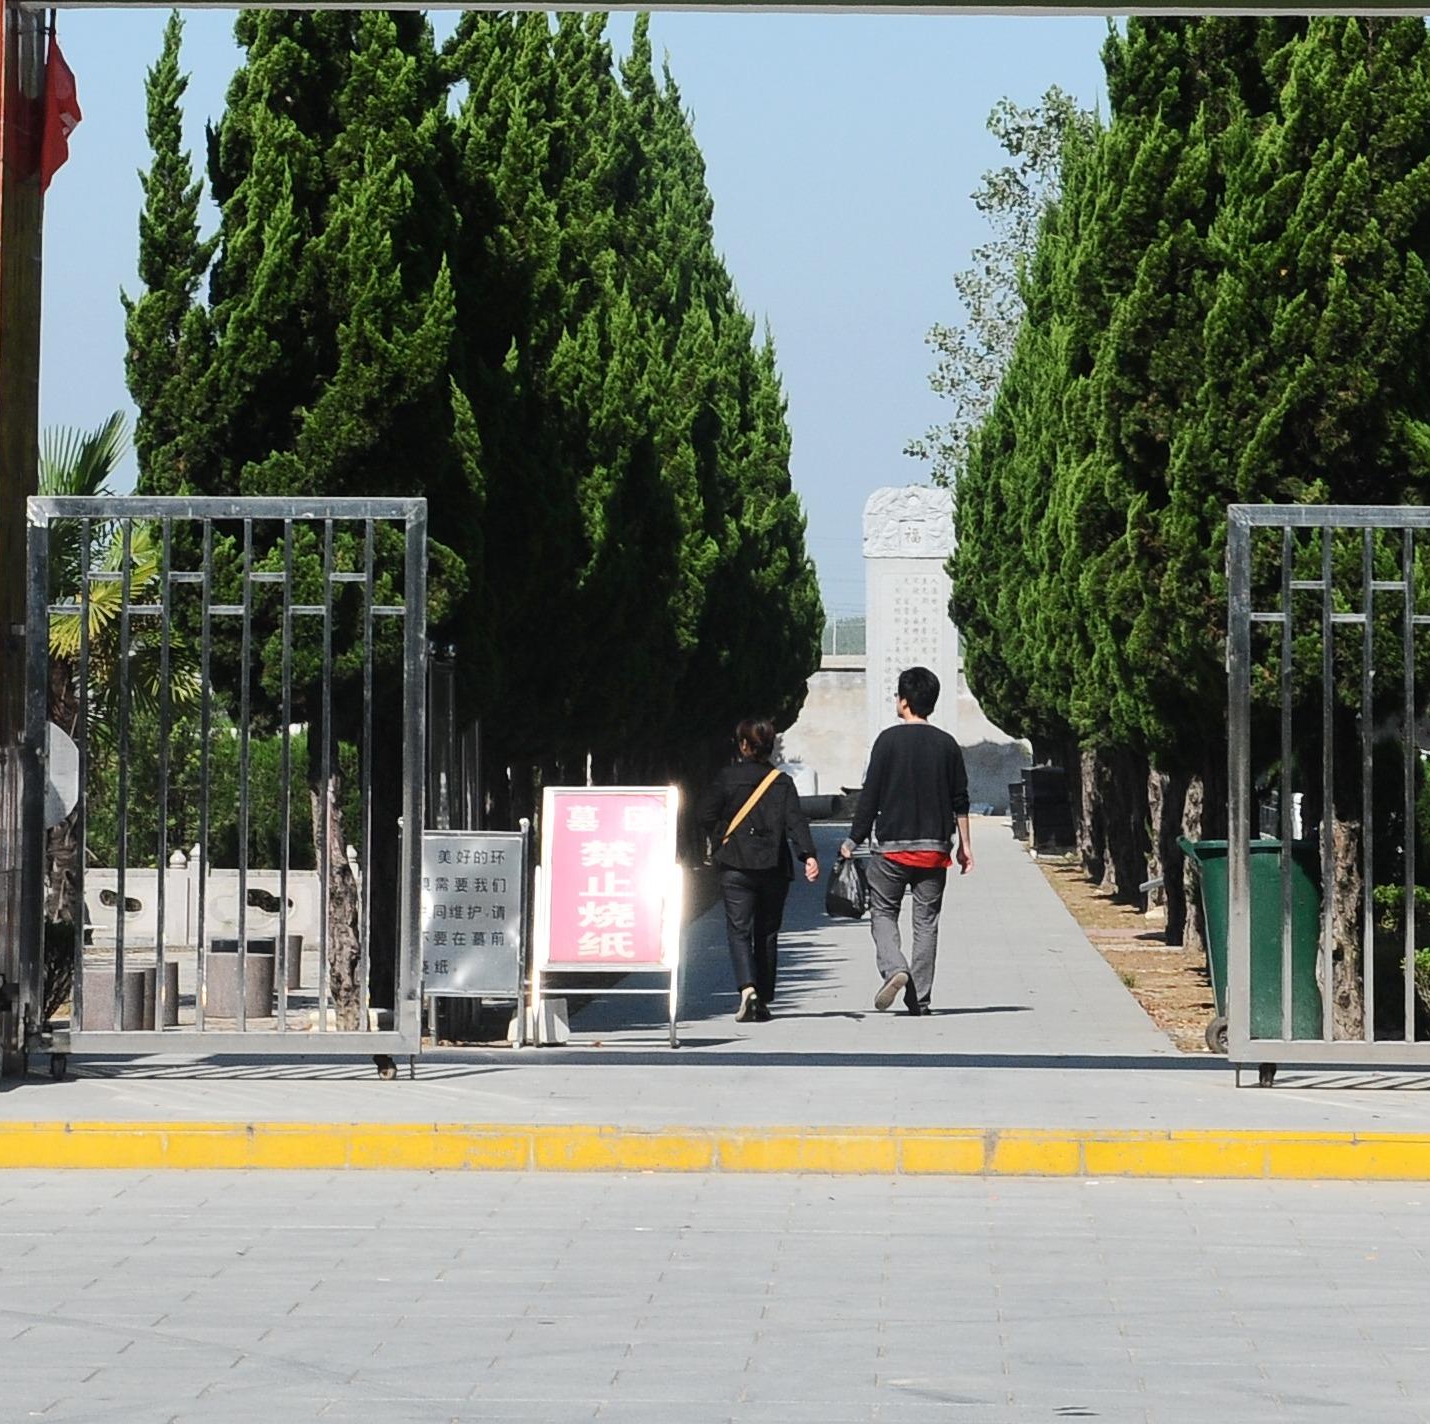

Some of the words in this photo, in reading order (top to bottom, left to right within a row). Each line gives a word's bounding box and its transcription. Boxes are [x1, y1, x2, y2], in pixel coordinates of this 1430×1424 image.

[438, 849, 506, 865] 美好的环
[578, 840, 636, 959] 禁止烧纸
